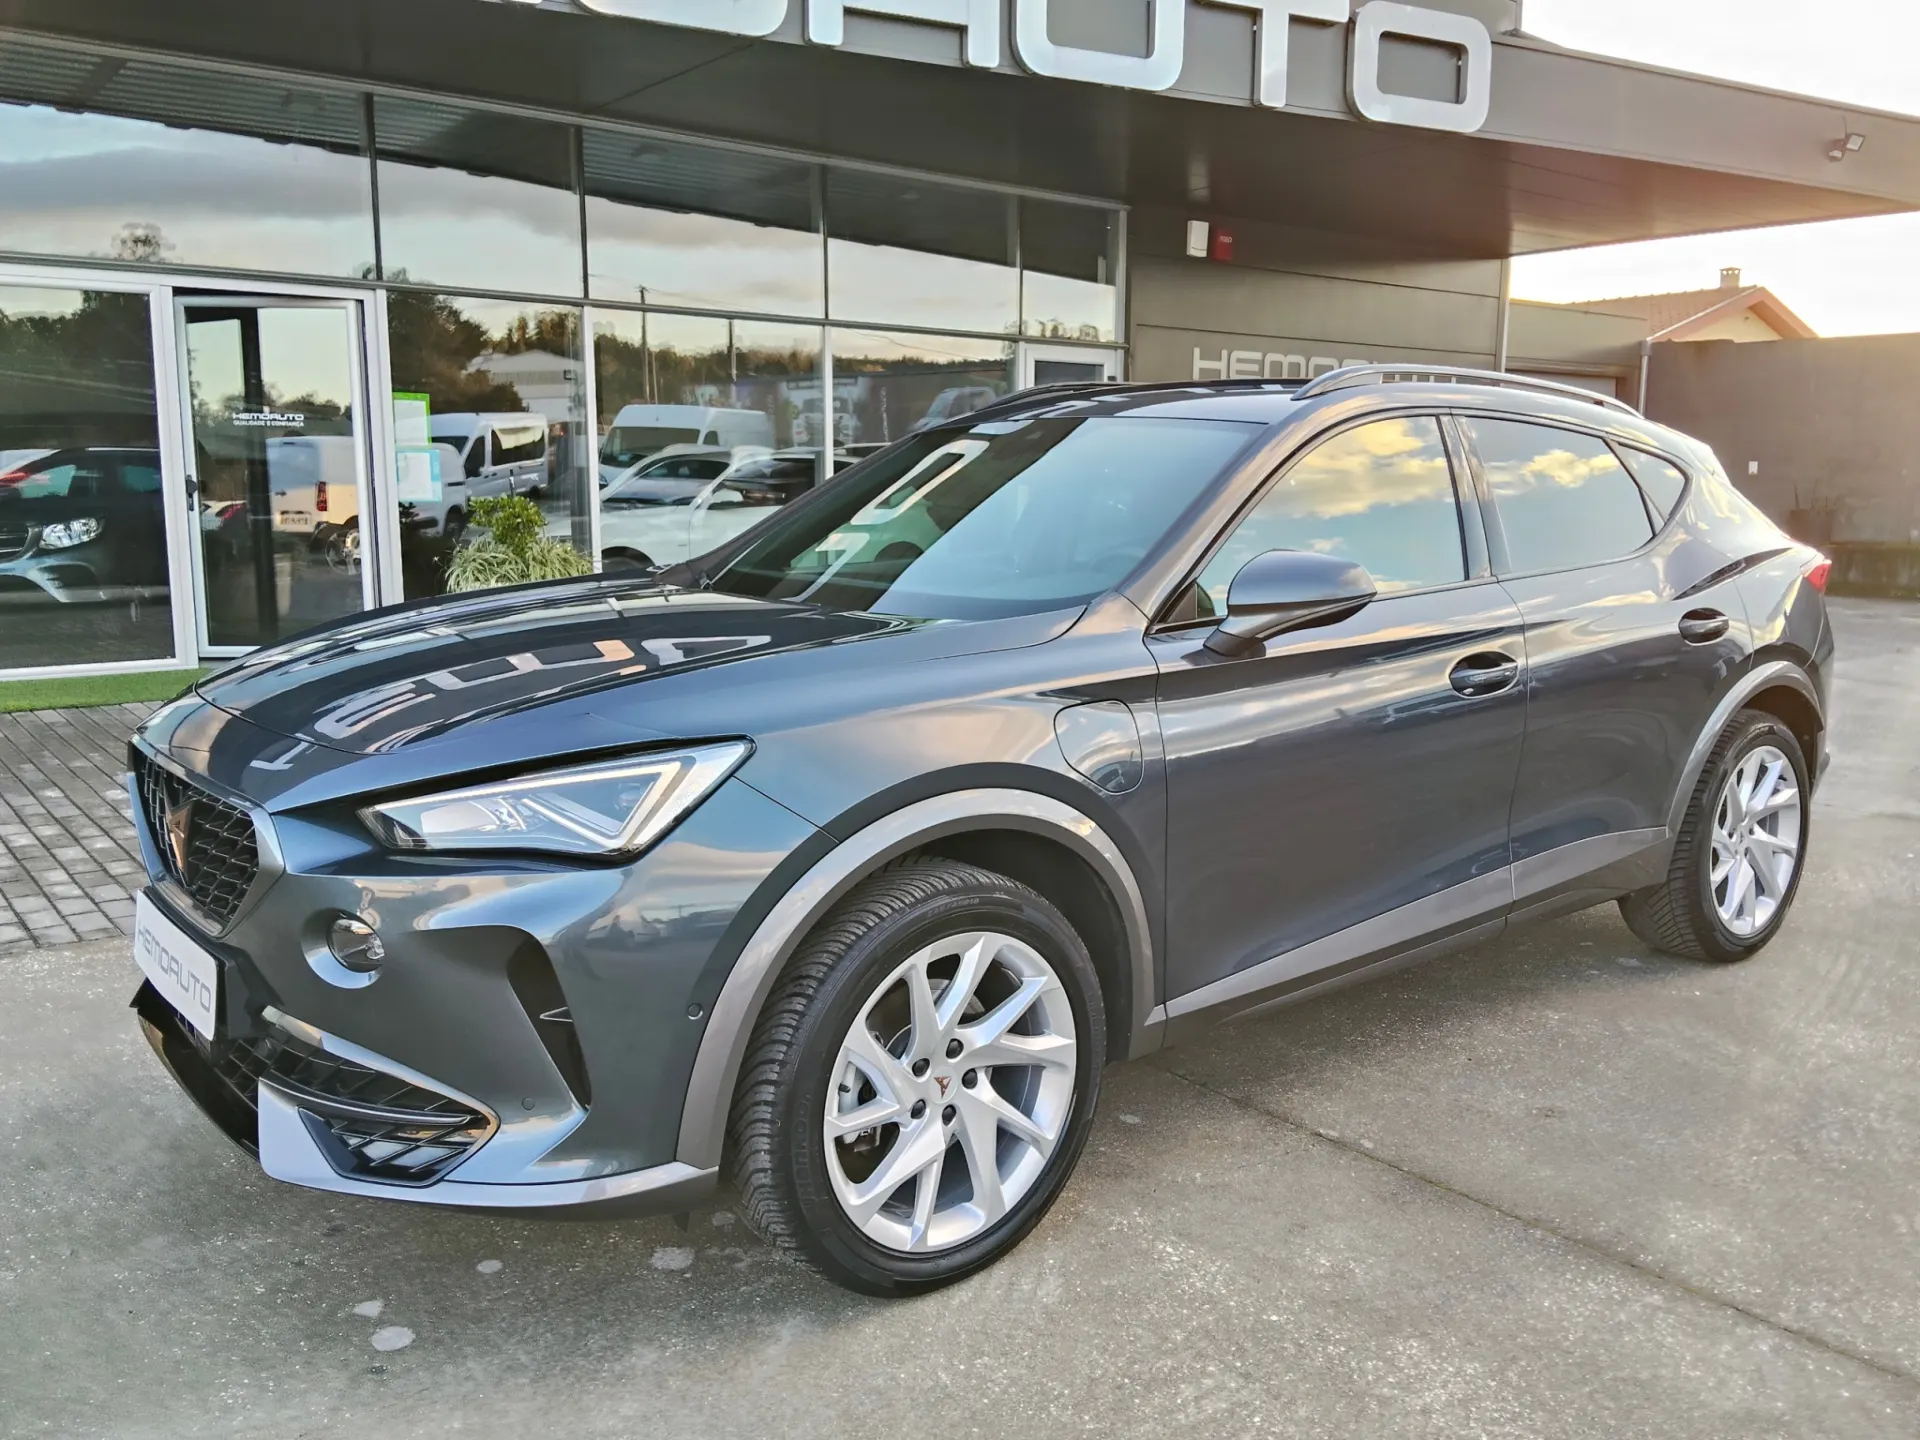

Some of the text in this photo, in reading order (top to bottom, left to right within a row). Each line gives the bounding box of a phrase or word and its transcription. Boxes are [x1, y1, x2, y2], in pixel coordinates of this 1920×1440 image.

[1192, 346, 1456, 383] HEMO
[232, 412, 304, 421] HEMOAUTO
[137, 921, 212, 1014] HEMOAUTO
